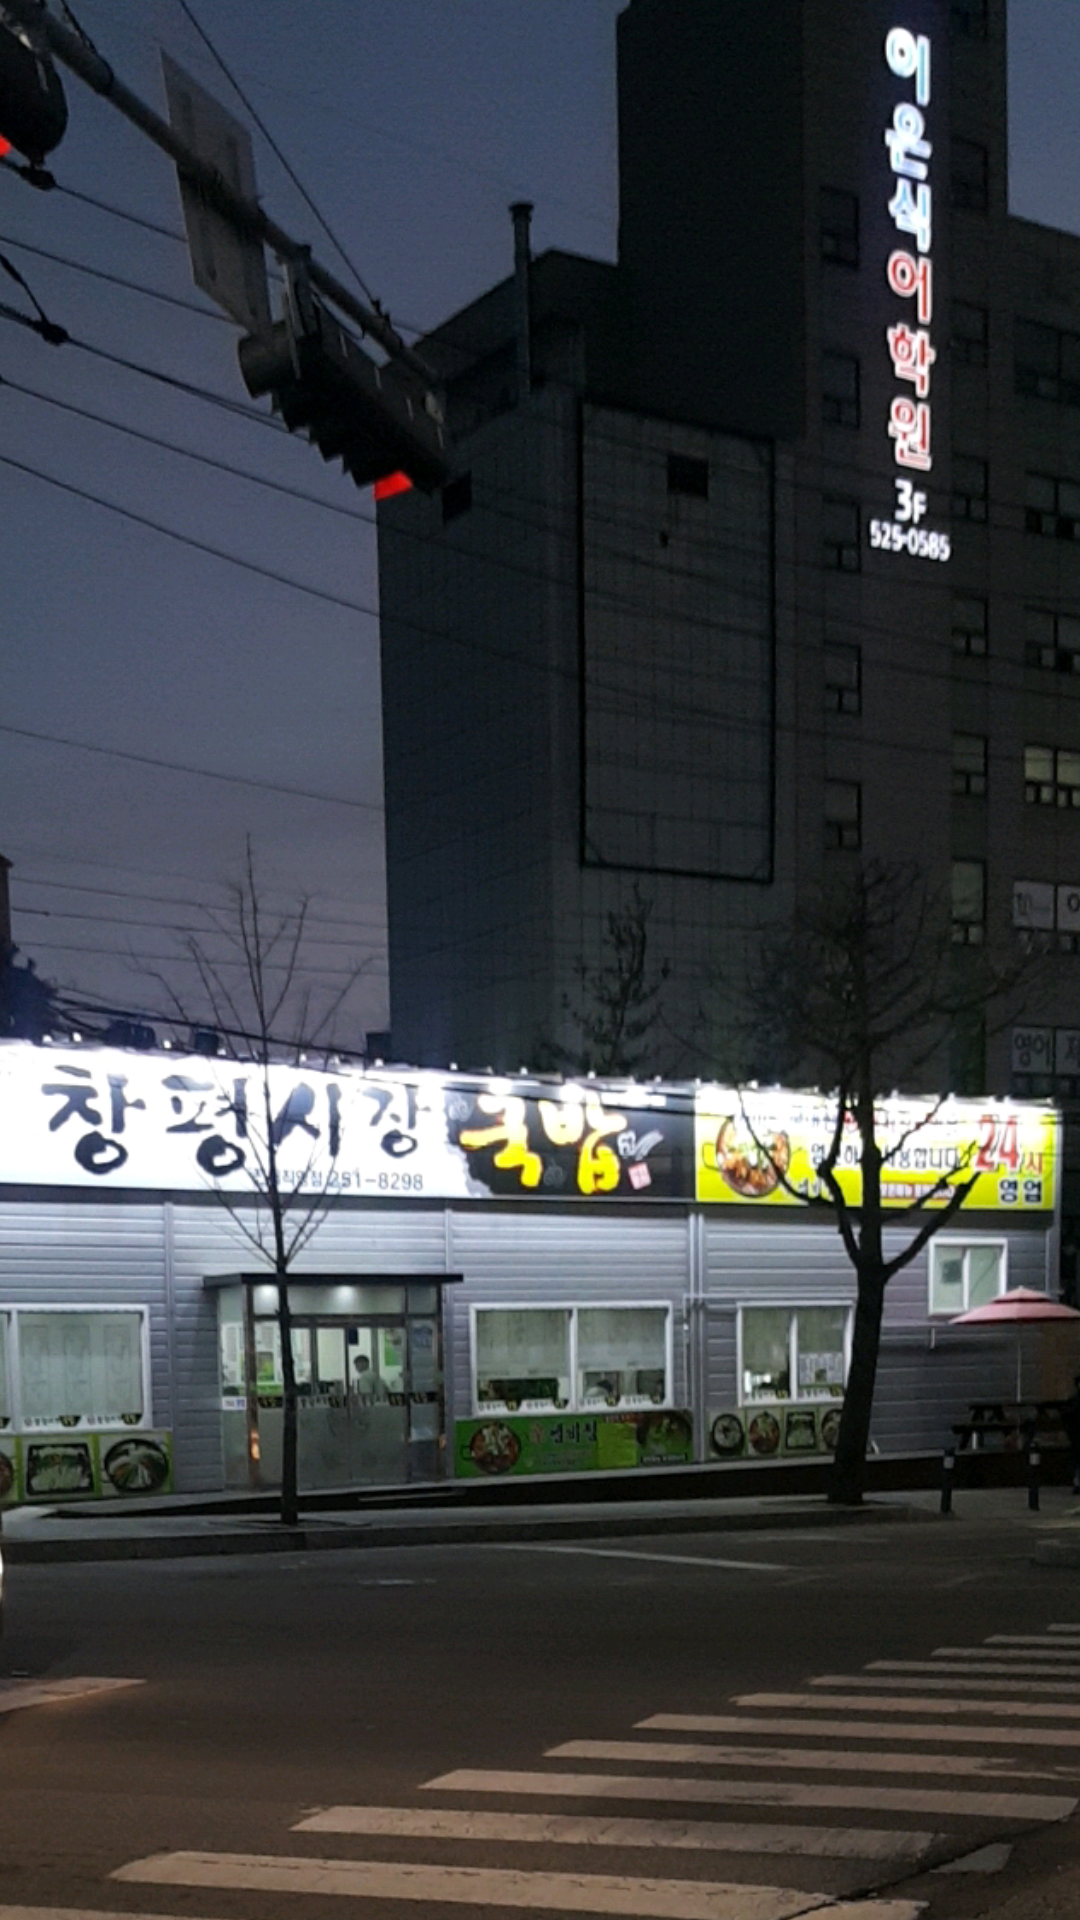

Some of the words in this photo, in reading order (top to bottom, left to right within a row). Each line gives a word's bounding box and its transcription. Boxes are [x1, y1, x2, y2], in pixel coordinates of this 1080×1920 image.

[894, 477, 927, 524] 3F
[869, 518, 951, 562] 525-0585
[41, 1064, 431, 1176] 창평시장
[459, 1090, 628, 1195] 국밥
[999, 1178, 1043, 1203] 영업
